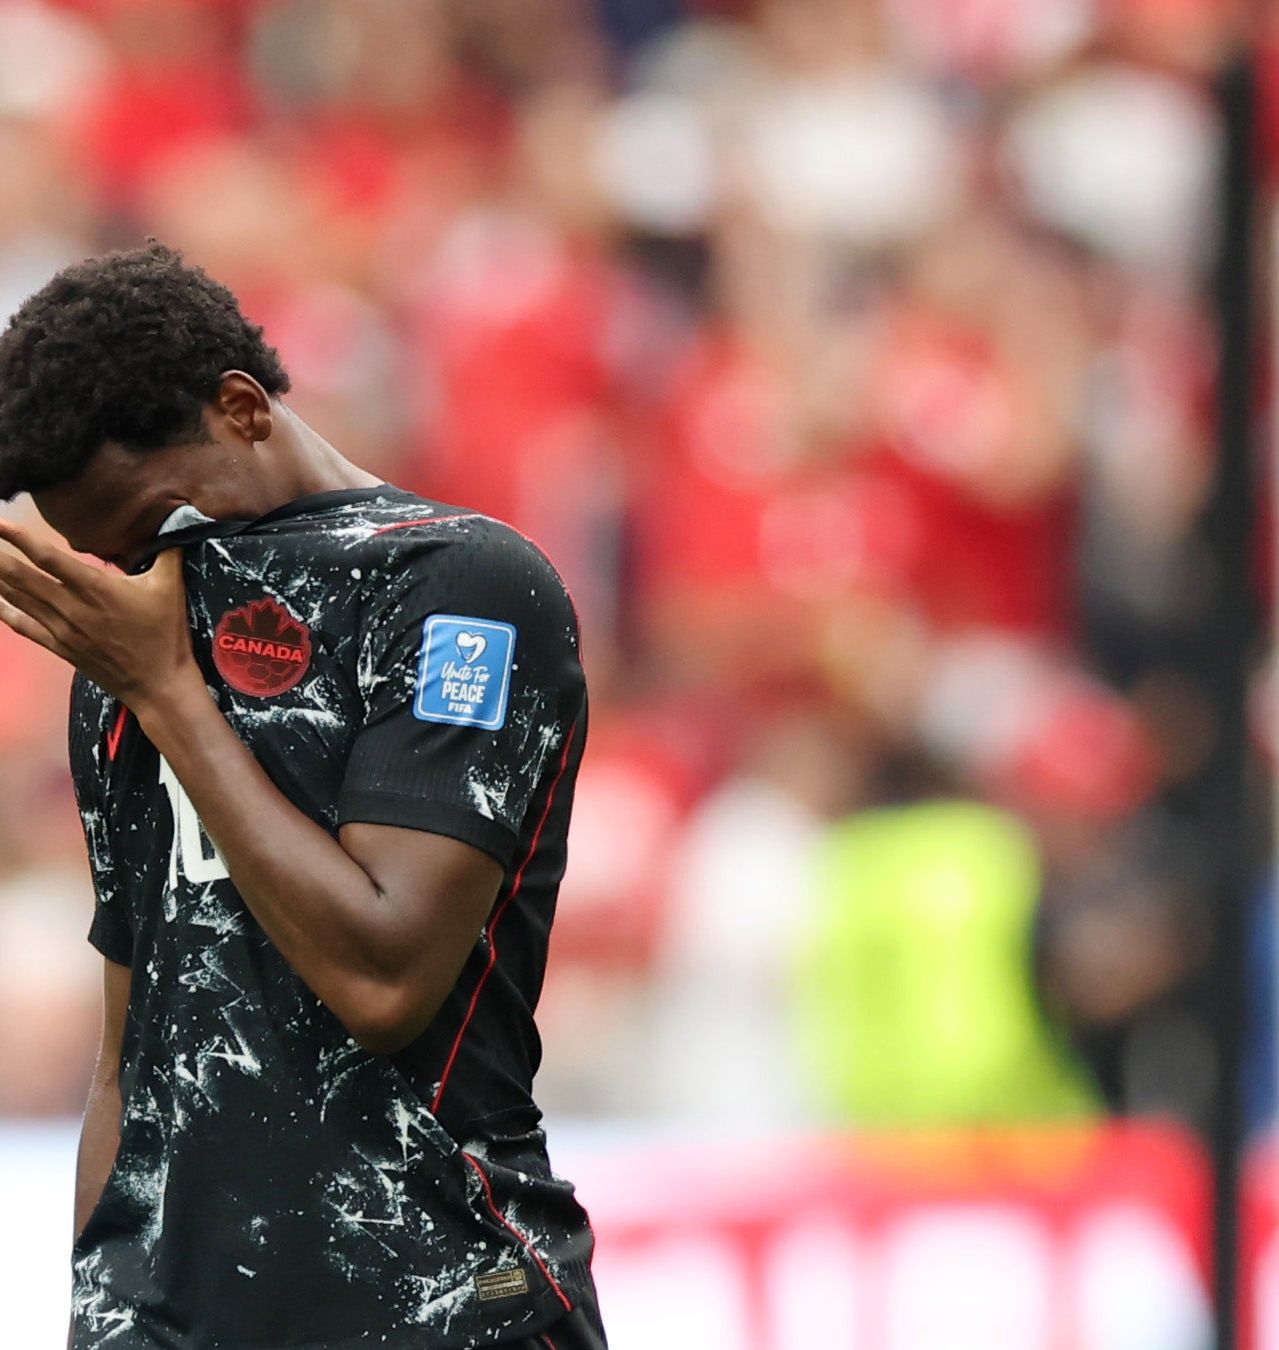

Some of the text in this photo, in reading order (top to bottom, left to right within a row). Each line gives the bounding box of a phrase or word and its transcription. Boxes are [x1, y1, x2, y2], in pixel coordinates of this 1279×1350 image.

[217, 634, 304, 663] CANADA
[440, 660, 491, 683] Unite For
[441, 681, 486, 703] PEACE
